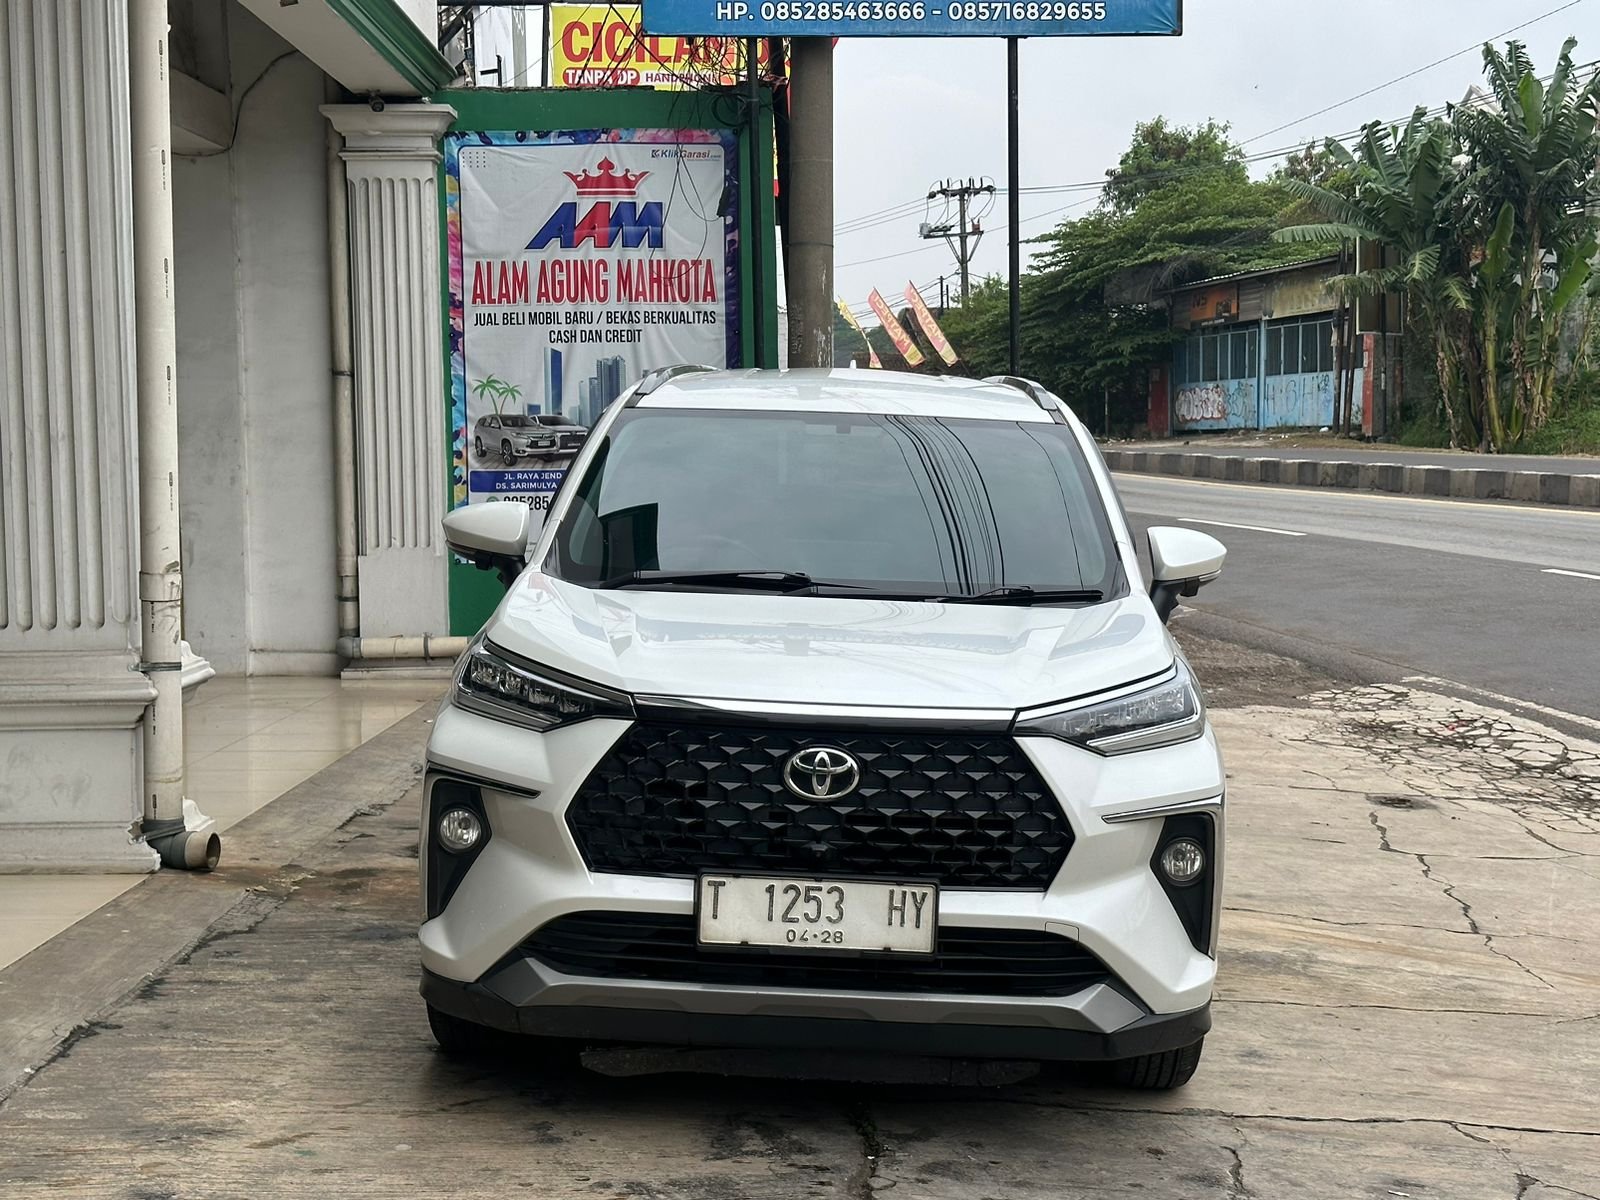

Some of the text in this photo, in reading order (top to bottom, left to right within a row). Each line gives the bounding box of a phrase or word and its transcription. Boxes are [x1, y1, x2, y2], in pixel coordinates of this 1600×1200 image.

[717, 2, 754, 20] HP.
[761, 1, 925, 20] 085285463666
[948, 1, 1107, 20] 085716829655
[566, 69, 638, 85] TANPA DP
[524, 201, 664, 249] AAM
[471, 258, 718, 305] ALAM AGUNG MAHKOTA
[474, 313, 499, 326] JUAL
[502, 312, 525, 325] BELI
[528, 311, 562, 325] MOBIL
[565, 311, 593, 325] BARU
[606, 310, 641, 325] BEKAS
[643, 310, 716, 325] BERKUALITAS
[549, 329, 642, 343] CASH DAN CREDIT
[504, 472, 515, 480] JL.
[517, 472, 539, 480] RAYA
[510, 481, 558, 490] SARIMULYA
[707, 880, 929, 929] T 1253 HY
